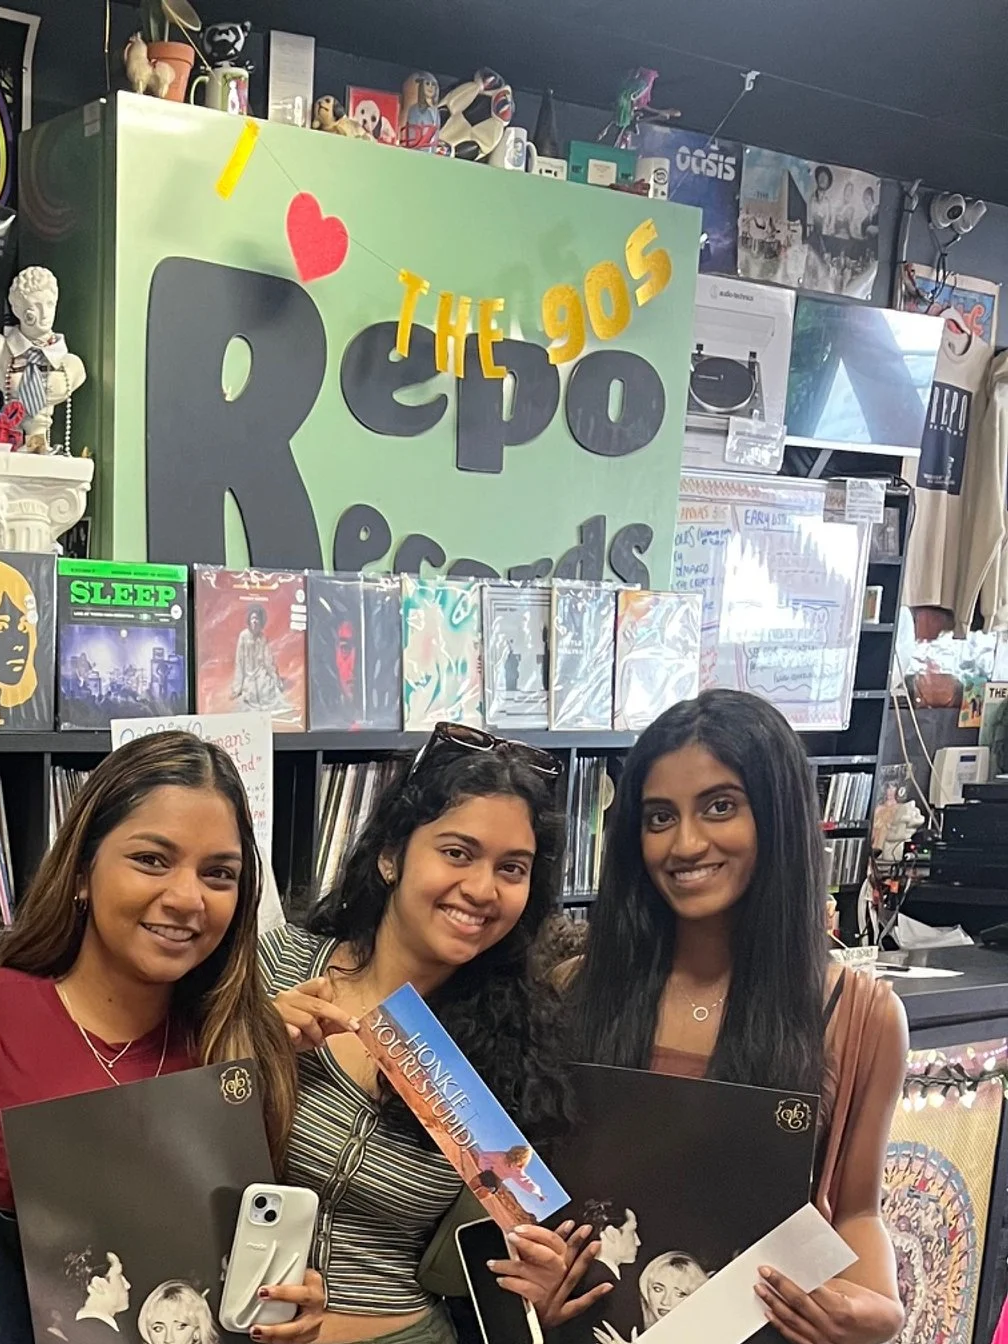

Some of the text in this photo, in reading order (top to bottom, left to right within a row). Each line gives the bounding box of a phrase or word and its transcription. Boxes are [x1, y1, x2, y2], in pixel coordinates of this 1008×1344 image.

[396, 268, 508, 379] THE
[146, 256, 667, 575] Repo
[929, 385, 969, 431] REPO
[70, 580, 177, 608] SLEEP
[989, 687, 1008, 698] THE
[369, 1014, 477, 1152] YOU'RE STUPID!
[405, 1032, 458, 1096] HONK
